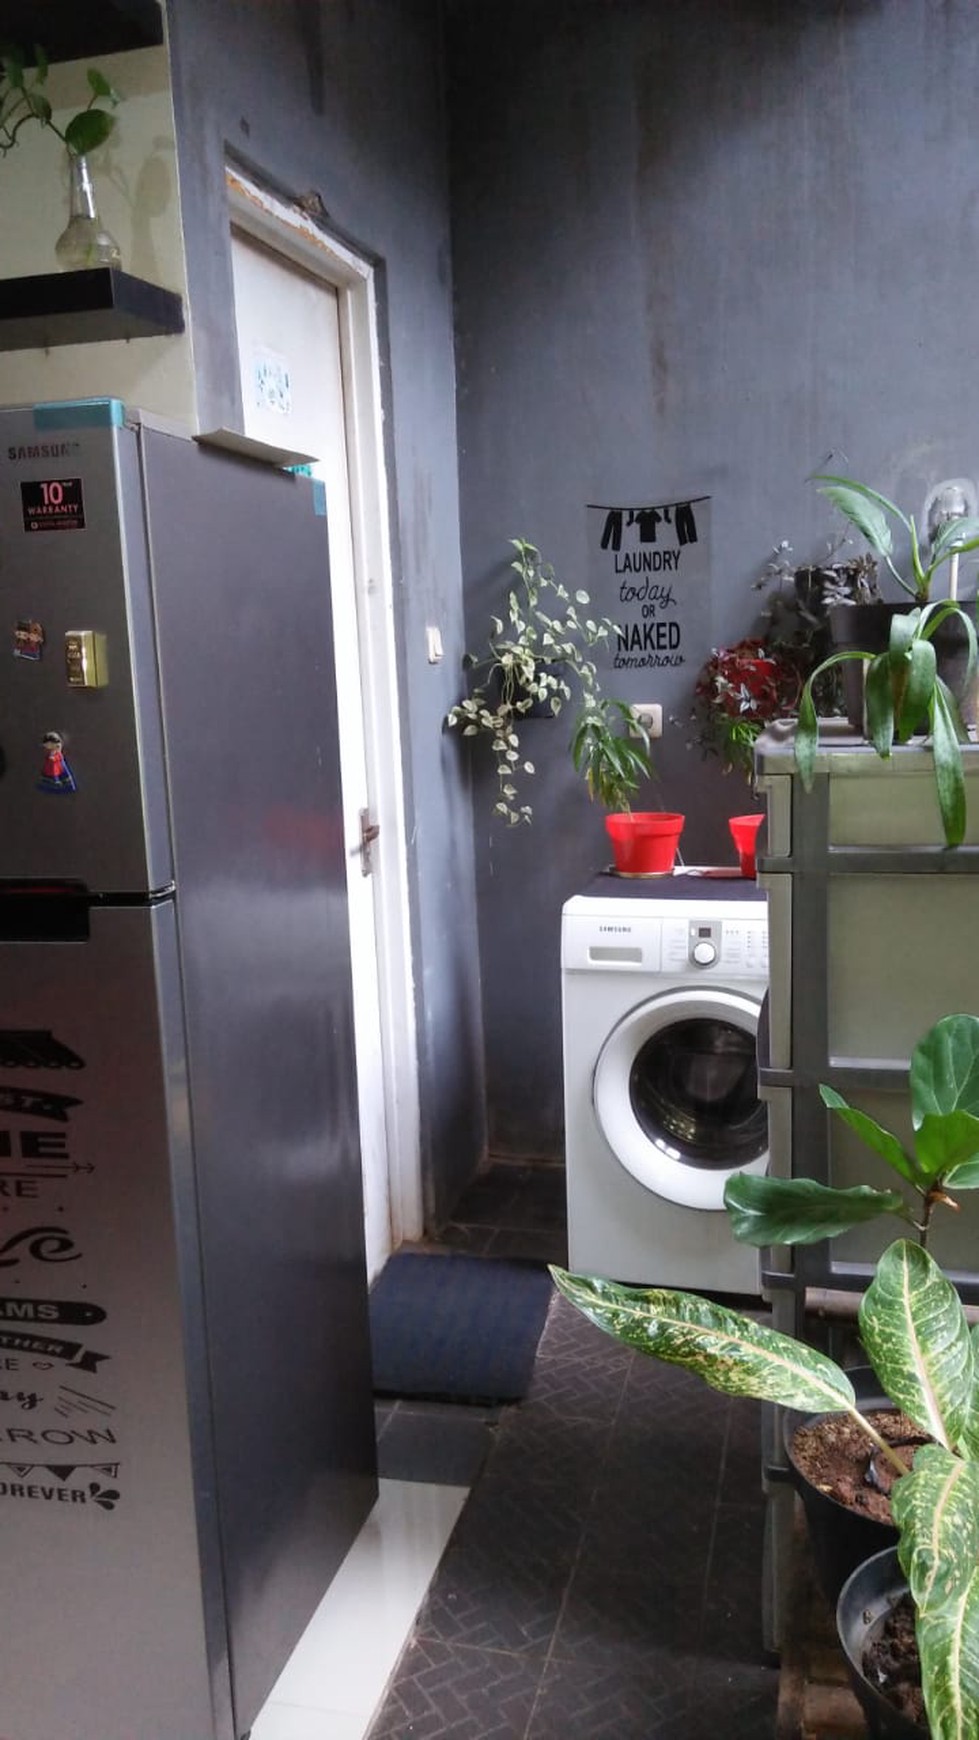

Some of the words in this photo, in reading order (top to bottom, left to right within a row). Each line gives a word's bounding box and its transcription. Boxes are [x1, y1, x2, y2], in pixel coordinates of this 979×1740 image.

[8, 442, 80, 460] SAMSUN
[40, 482, 63, 505] 10
[28, 504, 79, 515] WARRANTY
[615, 550, 681, 573] LAUNDRY
[620, 577, 677, 609] today
[642, 604, 655, 618] OR
[617, 622, 681, 651] NAKED
[613, 652, 685, 669] tomorrow
[0, 1302, 60, 1320] MS
[0, 1427, 118, 1445] ROW
